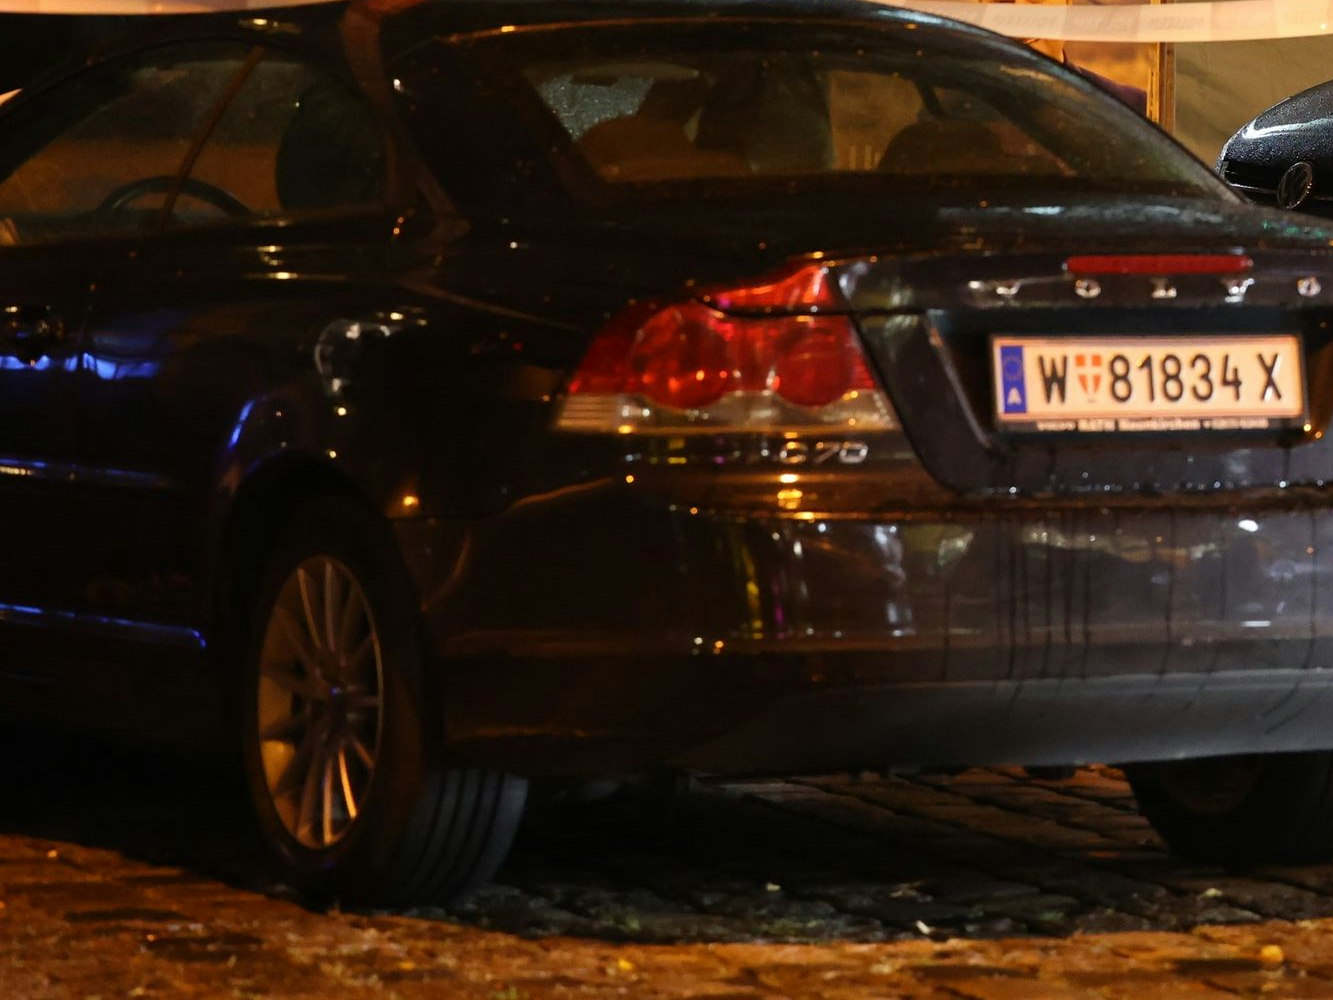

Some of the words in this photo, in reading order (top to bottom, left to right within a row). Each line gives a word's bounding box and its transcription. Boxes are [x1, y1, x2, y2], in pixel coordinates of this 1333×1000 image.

[1037, 354, 1069, 404] W
[1109, 353, 1243, 402] 81834
[1258, 352, 1283, 401] X
